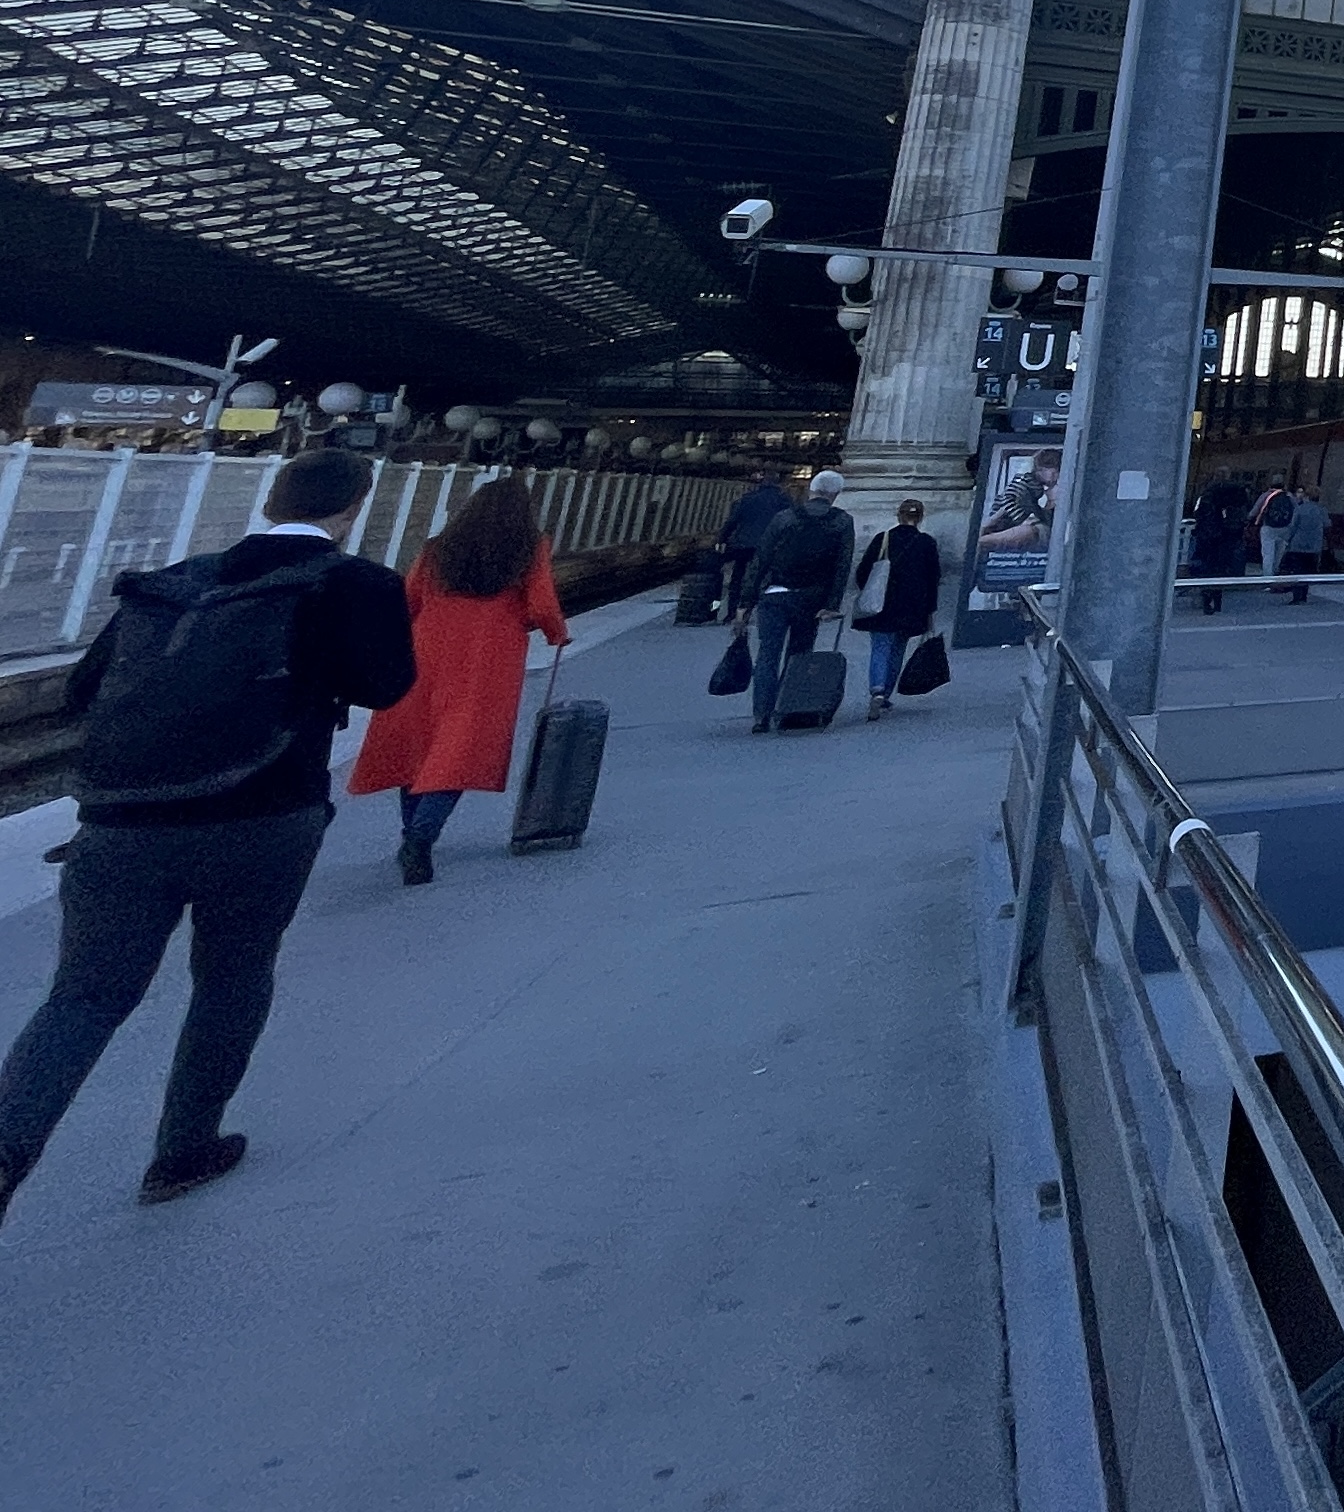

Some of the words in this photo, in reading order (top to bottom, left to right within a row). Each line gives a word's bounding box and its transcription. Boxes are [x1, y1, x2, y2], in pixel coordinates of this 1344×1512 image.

[984, 326, 1004, 340] 14
[1202, 334, 1218, 346] 13
[1019, 332, 1056, 371] U
[983, 382, 1001, 394] 14
